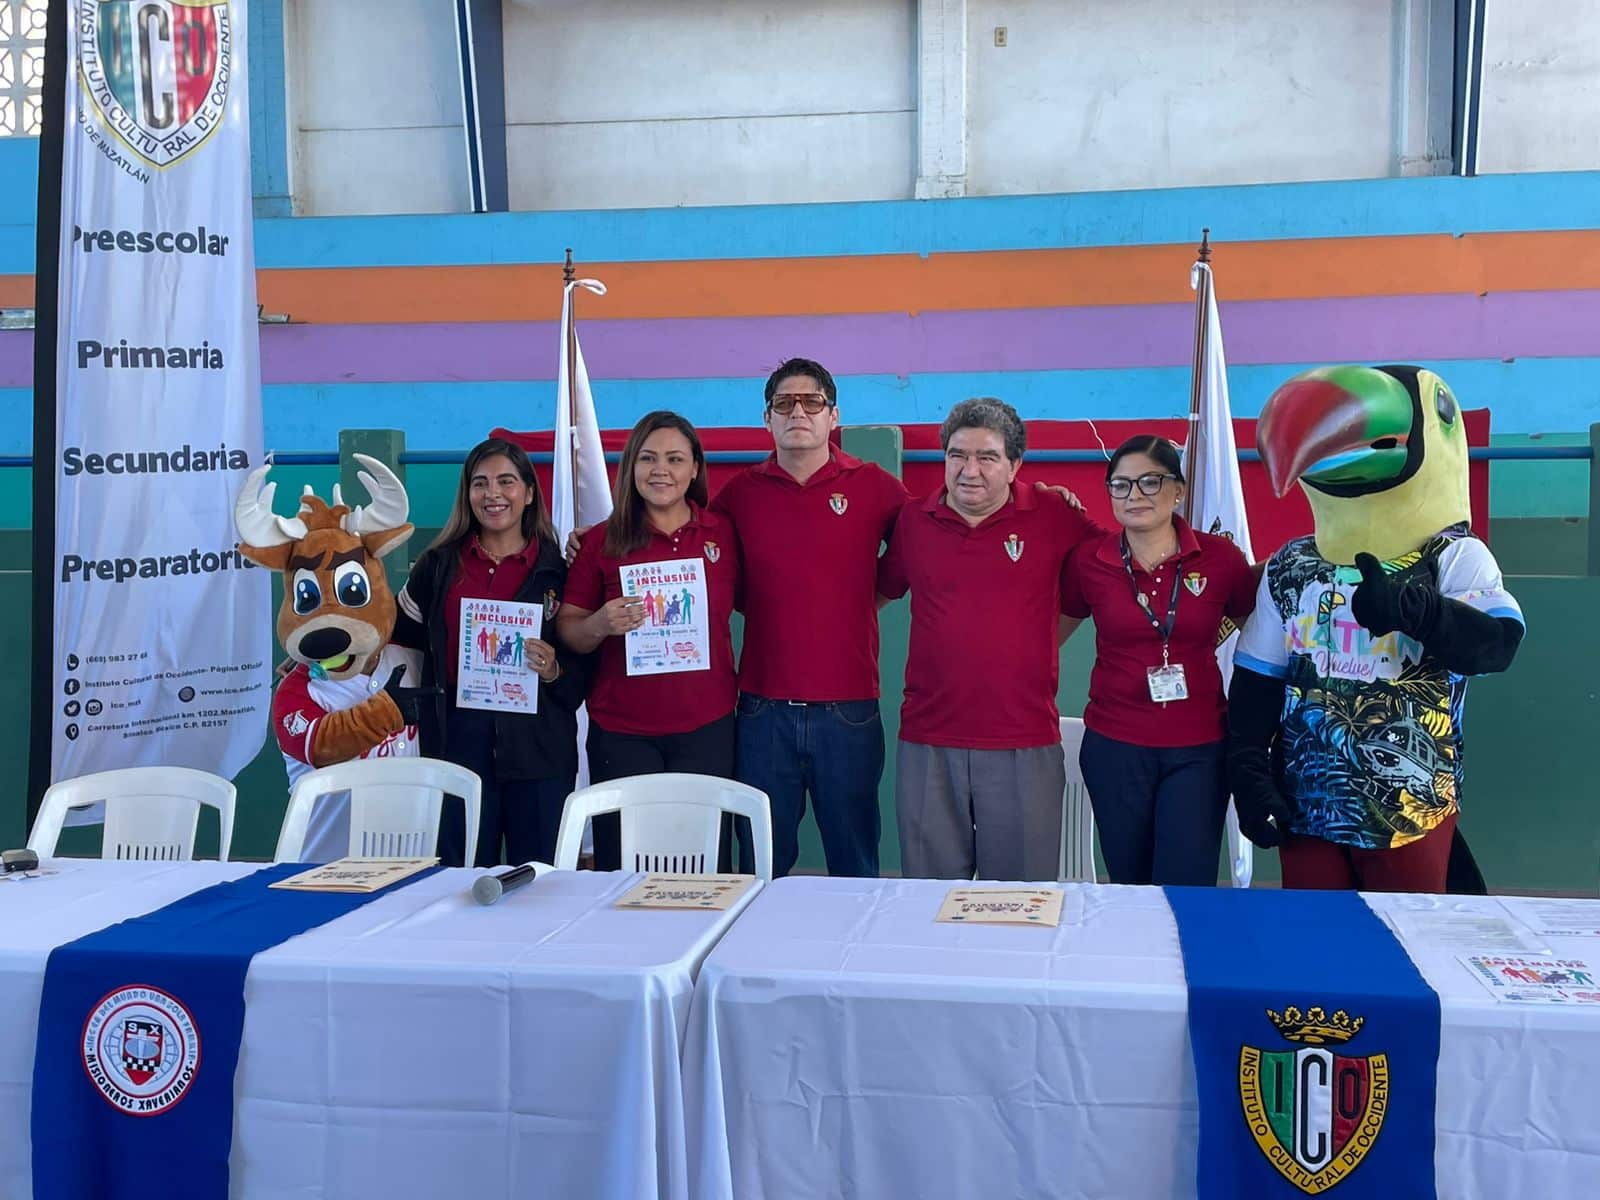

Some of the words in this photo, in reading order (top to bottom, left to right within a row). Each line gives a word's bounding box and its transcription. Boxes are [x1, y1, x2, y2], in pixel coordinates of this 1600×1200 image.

[195, 106, 217, 132] DE
[212, 9, 231, 106] OCCIDENTE
[85, 125, 101, 143] DE
[77, 339, 224, 369] Primaria
[63, 443, 250, 476] Secundaria
[637, 573, 697, 586] INCLUSIVA
[474, 613, 533, 626] INCLUSIVA
[1242, 1050, 1268, 1137] INSTITUTO
[1269, 1145, 1345, 1190] CULTURAL
[1343, 1145, 1364, 1167] DE
[1358, 1058, 1387, 1148] OCCIDENTE
